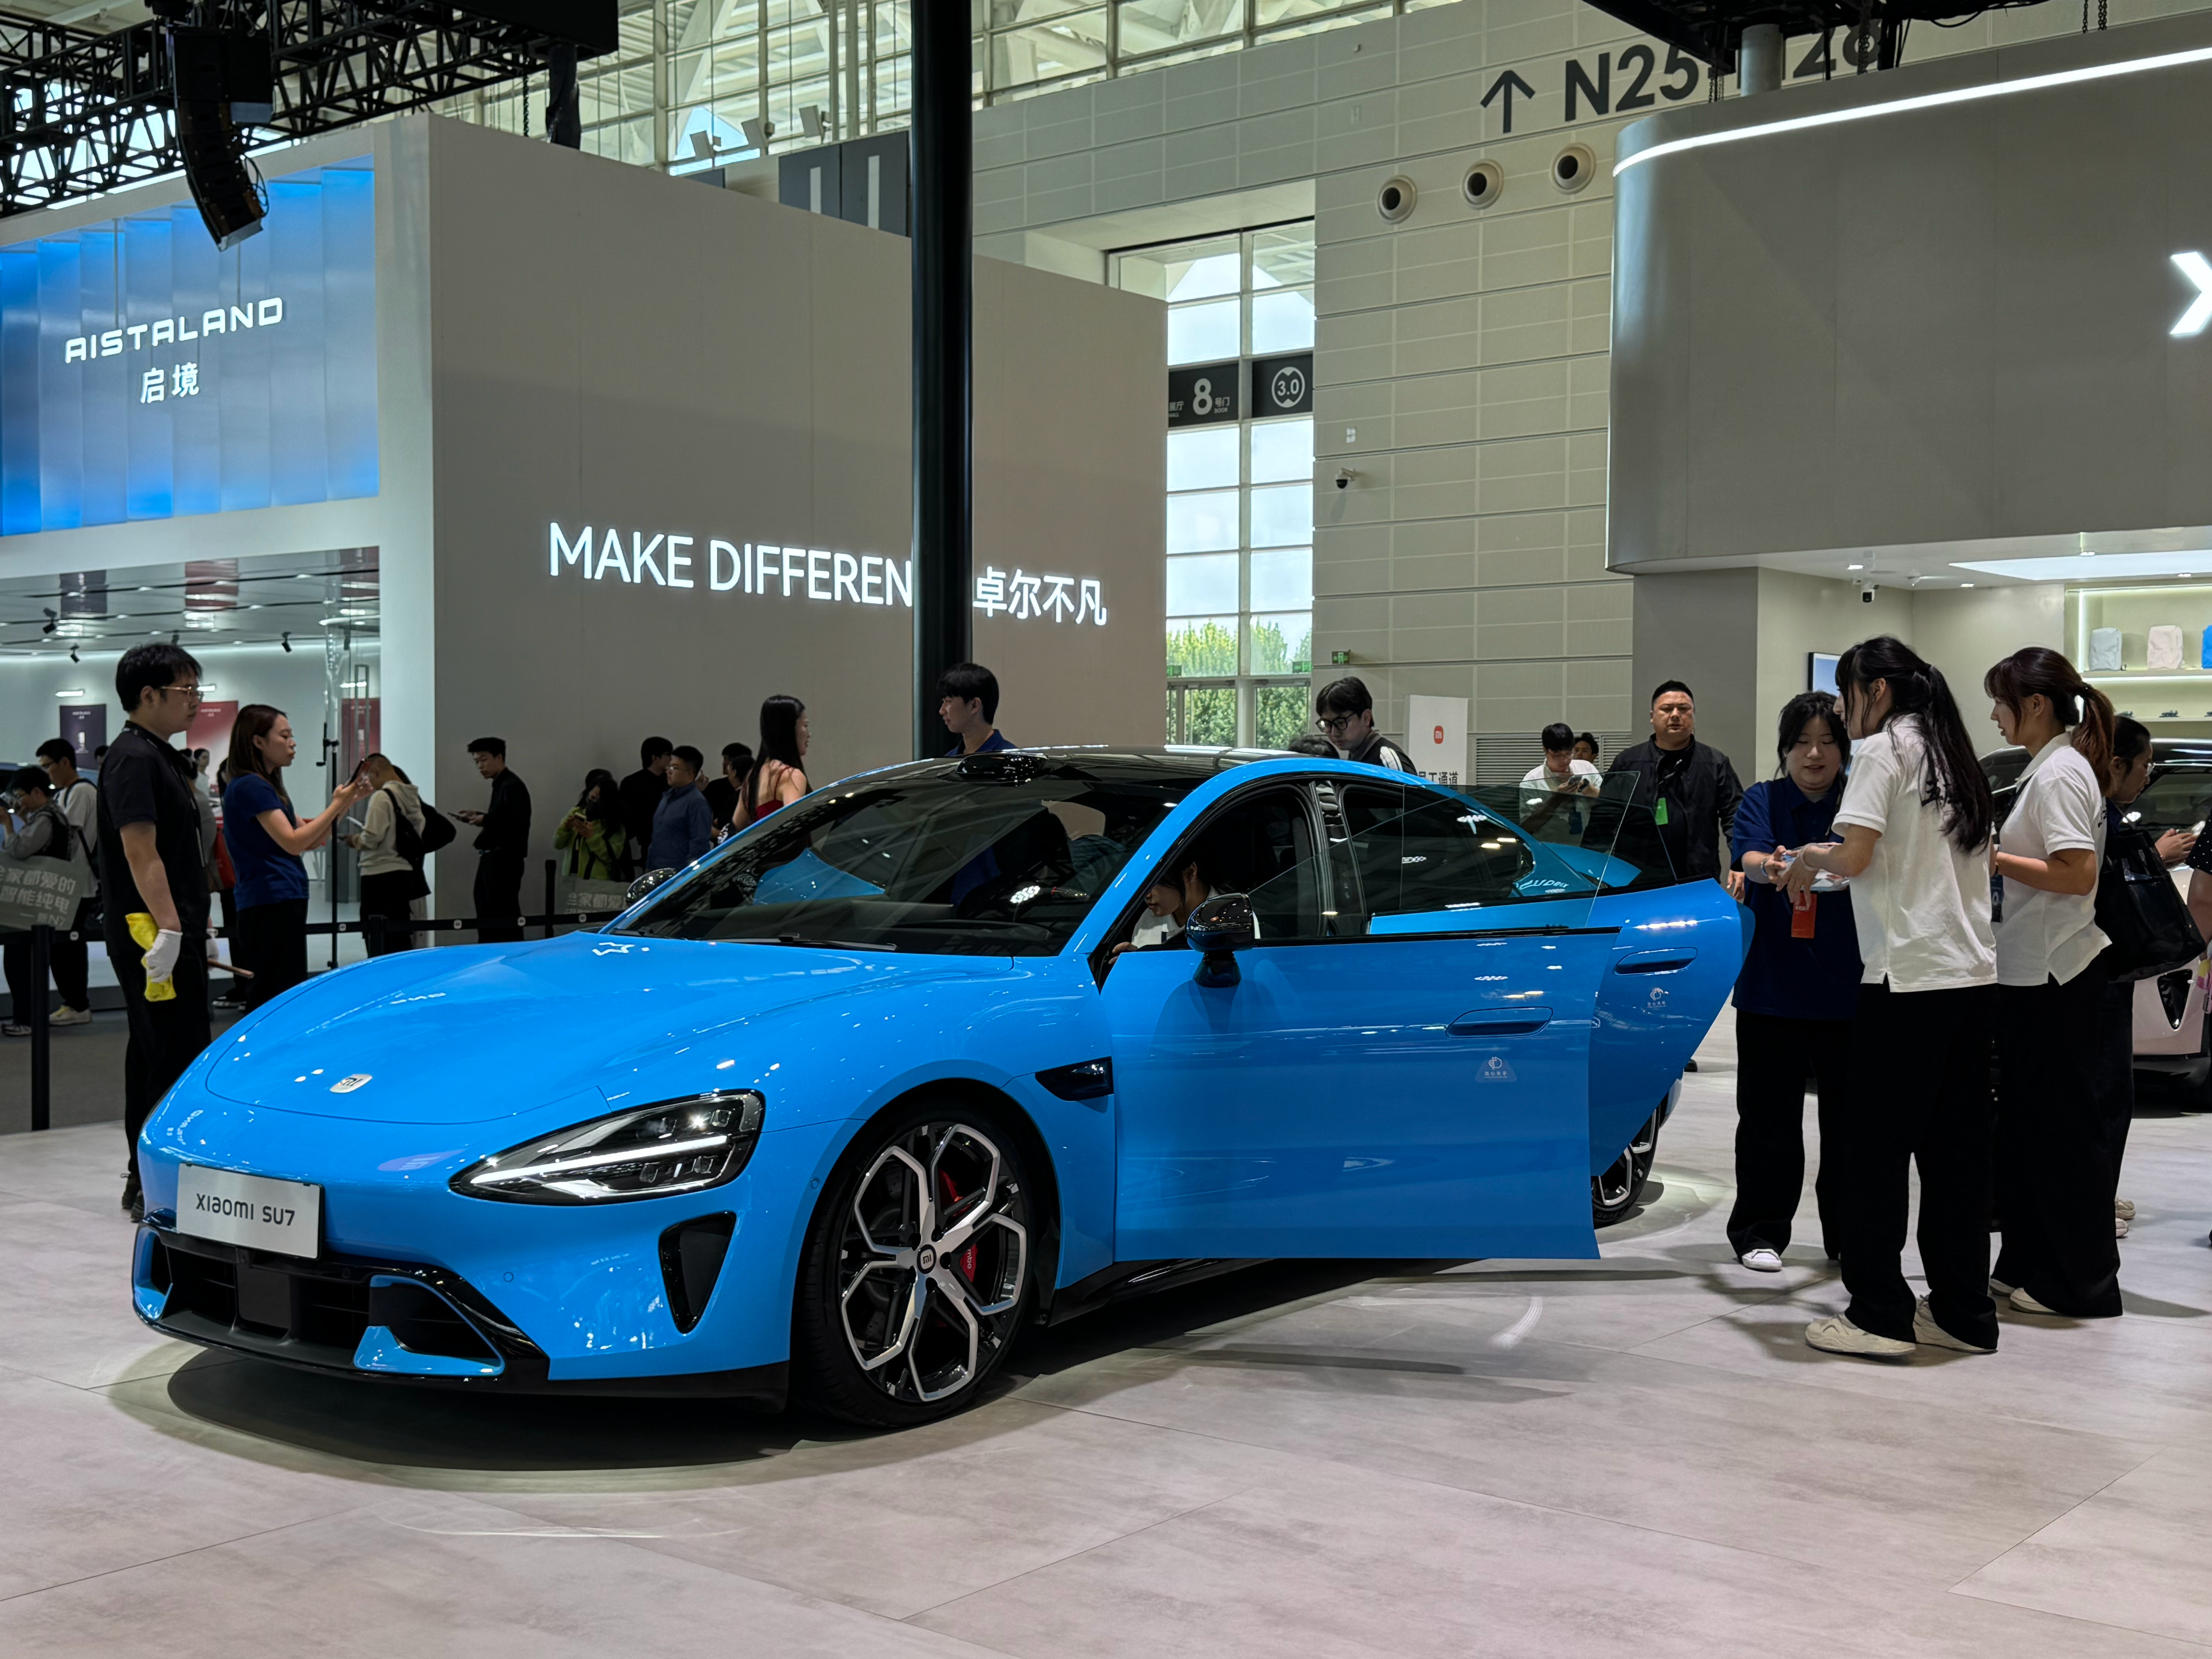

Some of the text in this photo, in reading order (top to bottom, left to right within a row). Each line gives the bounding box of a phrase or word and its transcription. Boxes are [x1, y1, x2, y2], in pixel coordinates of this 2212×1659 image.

[65, 297, 283, 364] AISTALAND
[140, 361, 199, 404] 启境
[1193, 378, 1212, 415] 8
[1215, 397, 1230, 407] 号门
[1277, 379, 1300, 397] 3.0
[550, 522, 1107, 626] MAKE DIFFEREN 卓尔不凡
[263, 1206, 295, 1226] SU7
